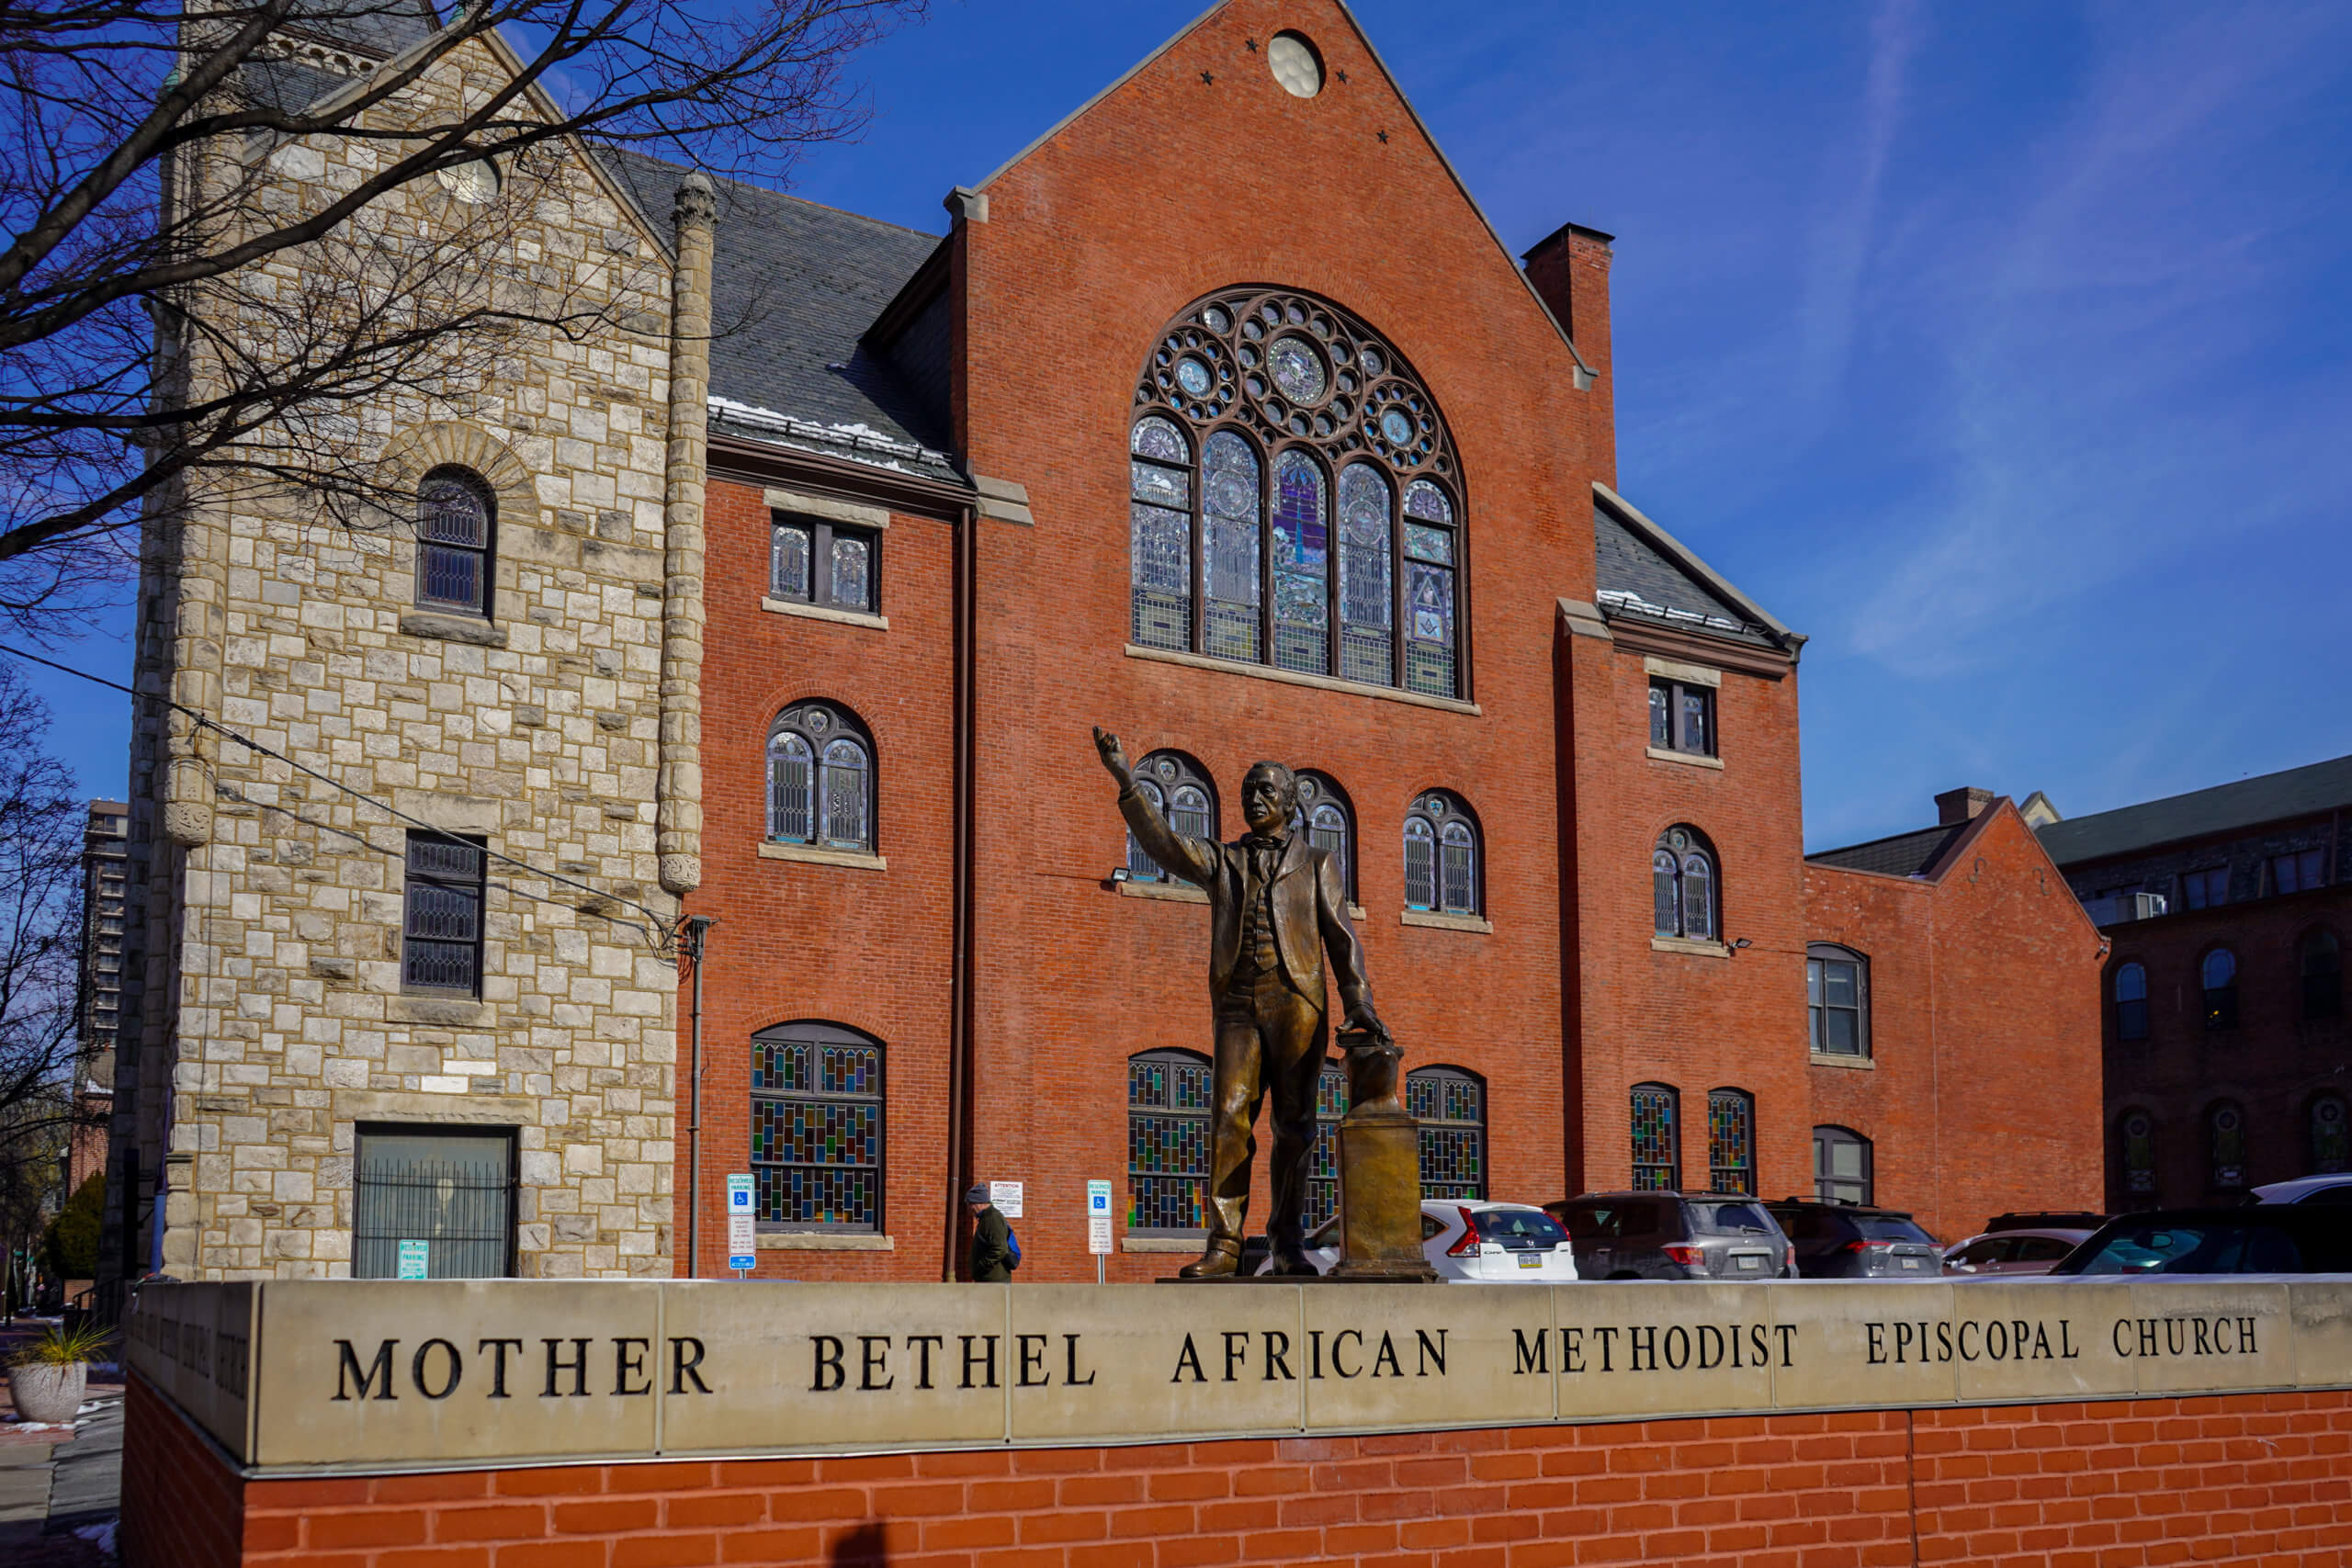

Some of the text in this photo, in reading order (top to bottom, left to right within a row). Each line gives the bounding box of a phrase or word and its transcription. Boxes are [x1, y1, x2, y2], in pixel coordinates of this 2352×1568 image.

[331, 1316, 2258, 1401] MOTHER BETHEL AFRICAN METHODIST EPISCOPAL CHURCH
